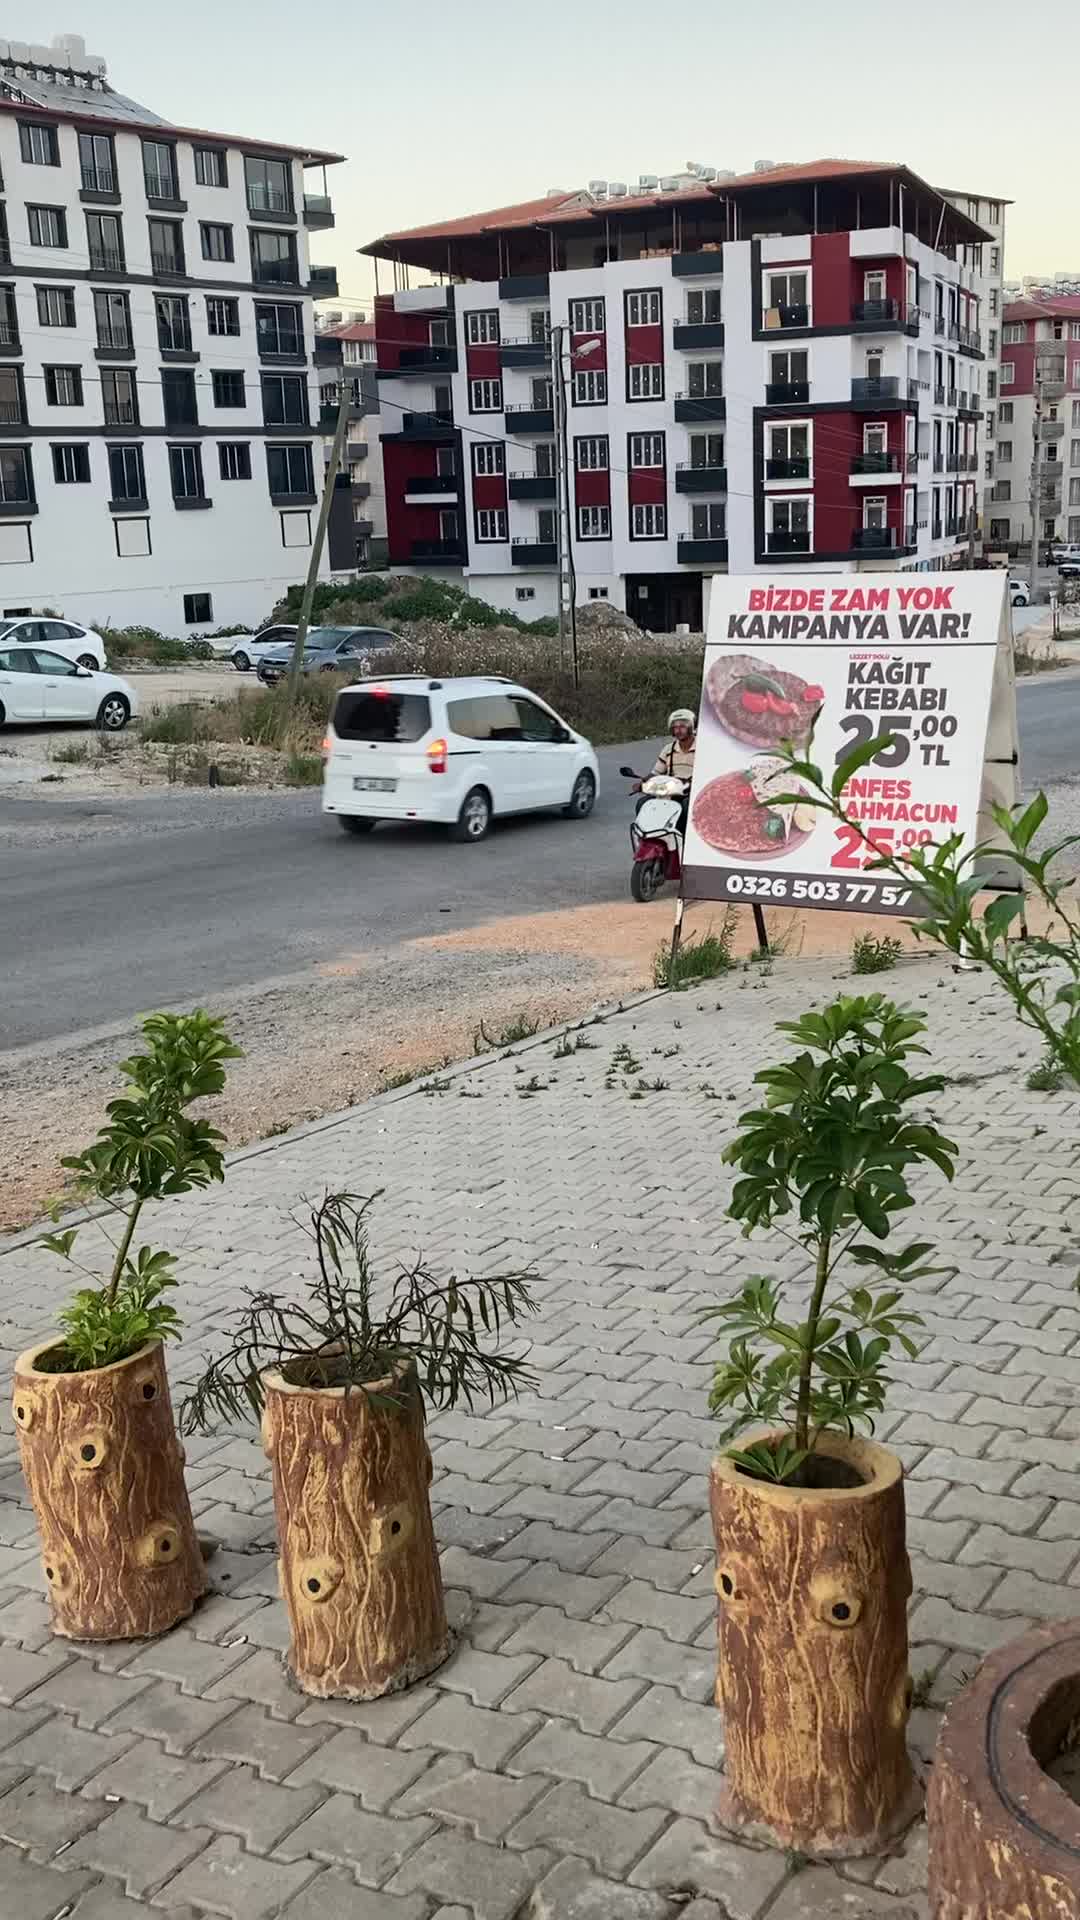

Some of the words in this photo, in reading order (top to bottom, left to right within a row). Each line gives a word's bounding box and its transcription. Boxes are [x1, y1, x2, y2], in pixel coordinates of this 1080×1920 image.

[749, 584, 825, 611] BİZDE
[829, 588, 891, 611] ZAM
[896, 587, 955, 611] YOK
[727, 614, 889, 640] KAMPANYA
[898, 613, 972, 639] VAR!
[848, 656, 931, 685] KAĞIT
[845, 688, 947, 711] KEBABI
[920, 744, 950, 766] TL
[840, 801, 958, 823] AHMACUN
[726, 875, 787, 898] 0326
[791, 880, 841, 902] 503
[845, 883, 877, 904] 77
[880, 887, 913, 907] 57
